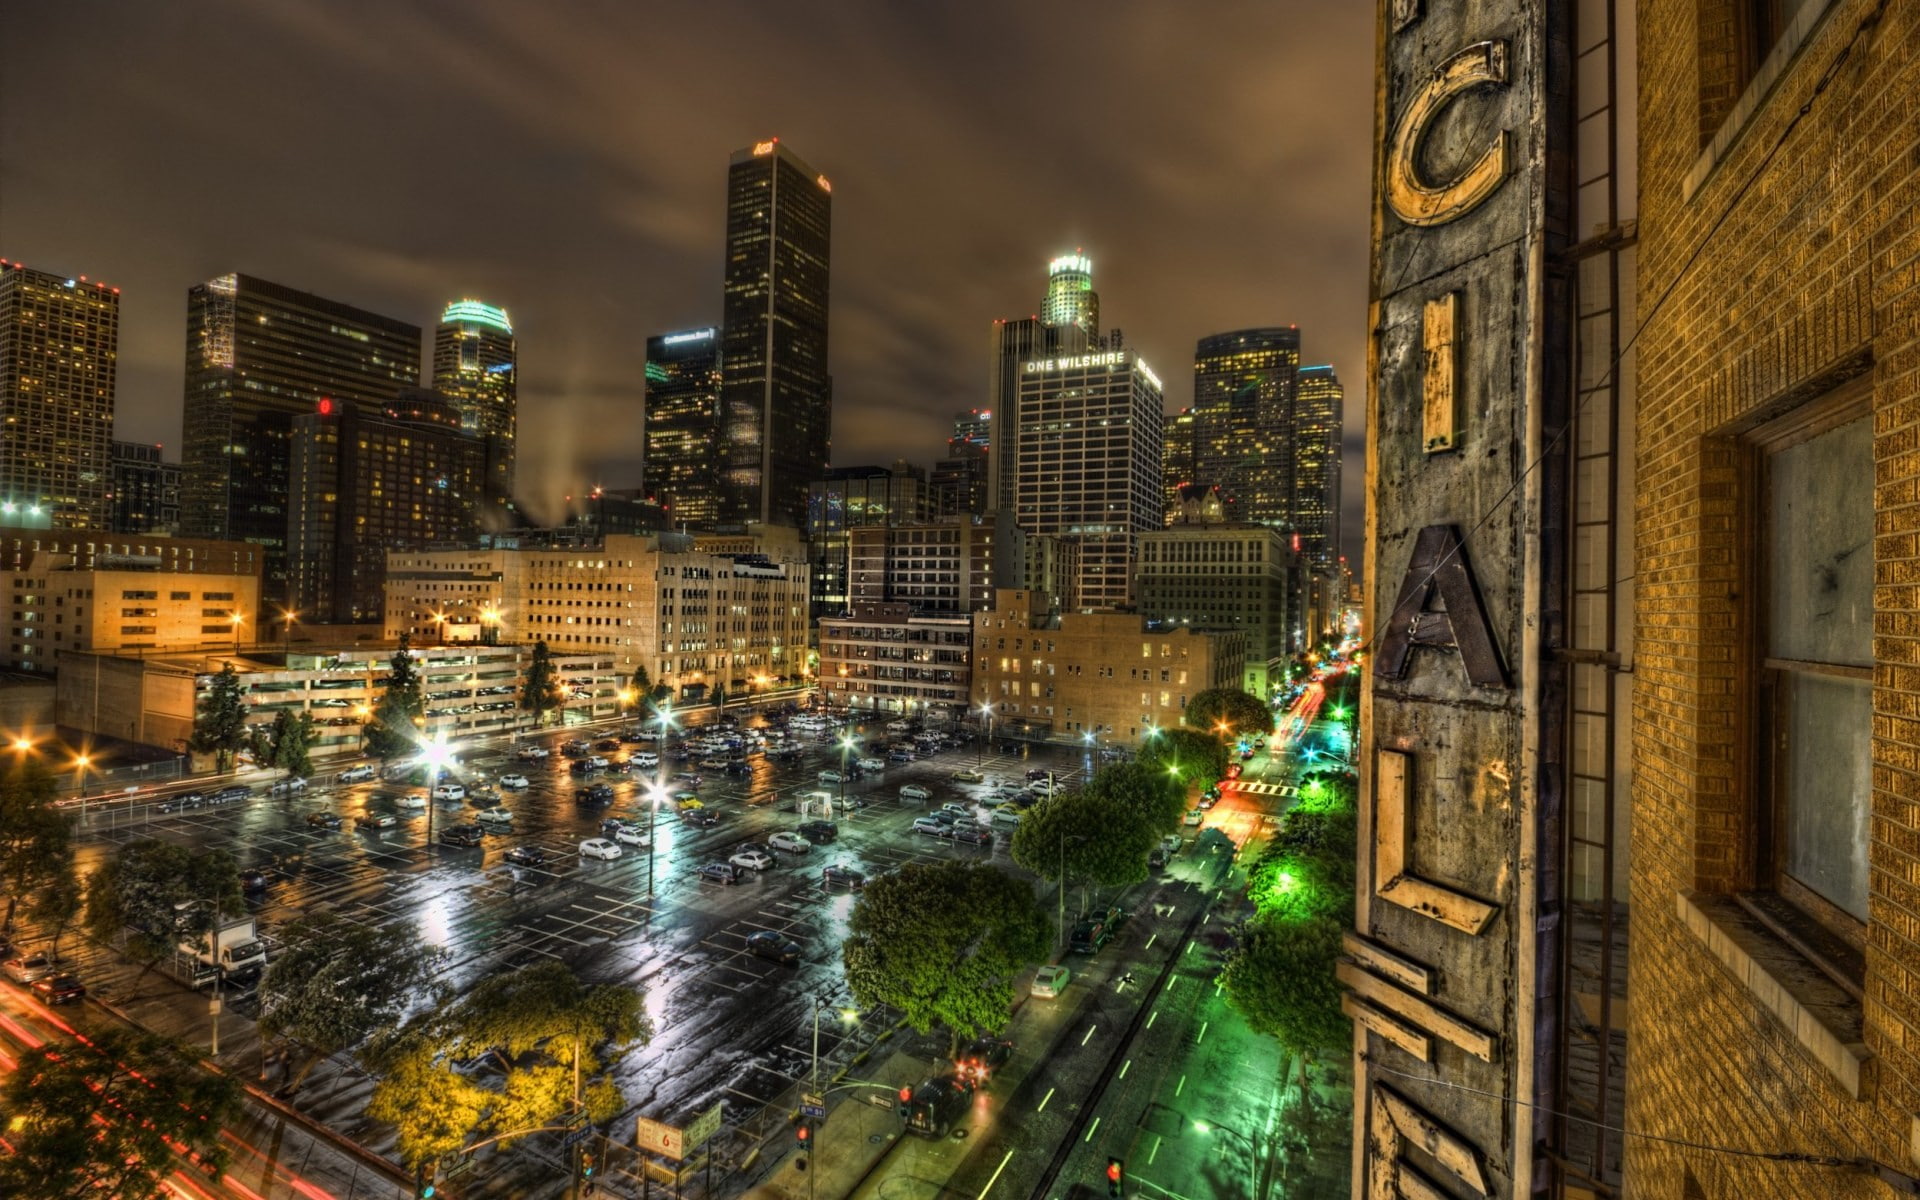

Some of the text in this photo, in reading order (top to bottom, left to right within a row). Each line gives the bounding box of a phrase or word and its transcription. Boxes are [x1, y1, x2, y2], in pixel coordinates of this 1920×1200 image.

[1027, 352, 1125, 373] ONE WILSHIRE
[1374, 0, 1512, 936] CIAL
[567, 1128, 591, 1145] Olive
